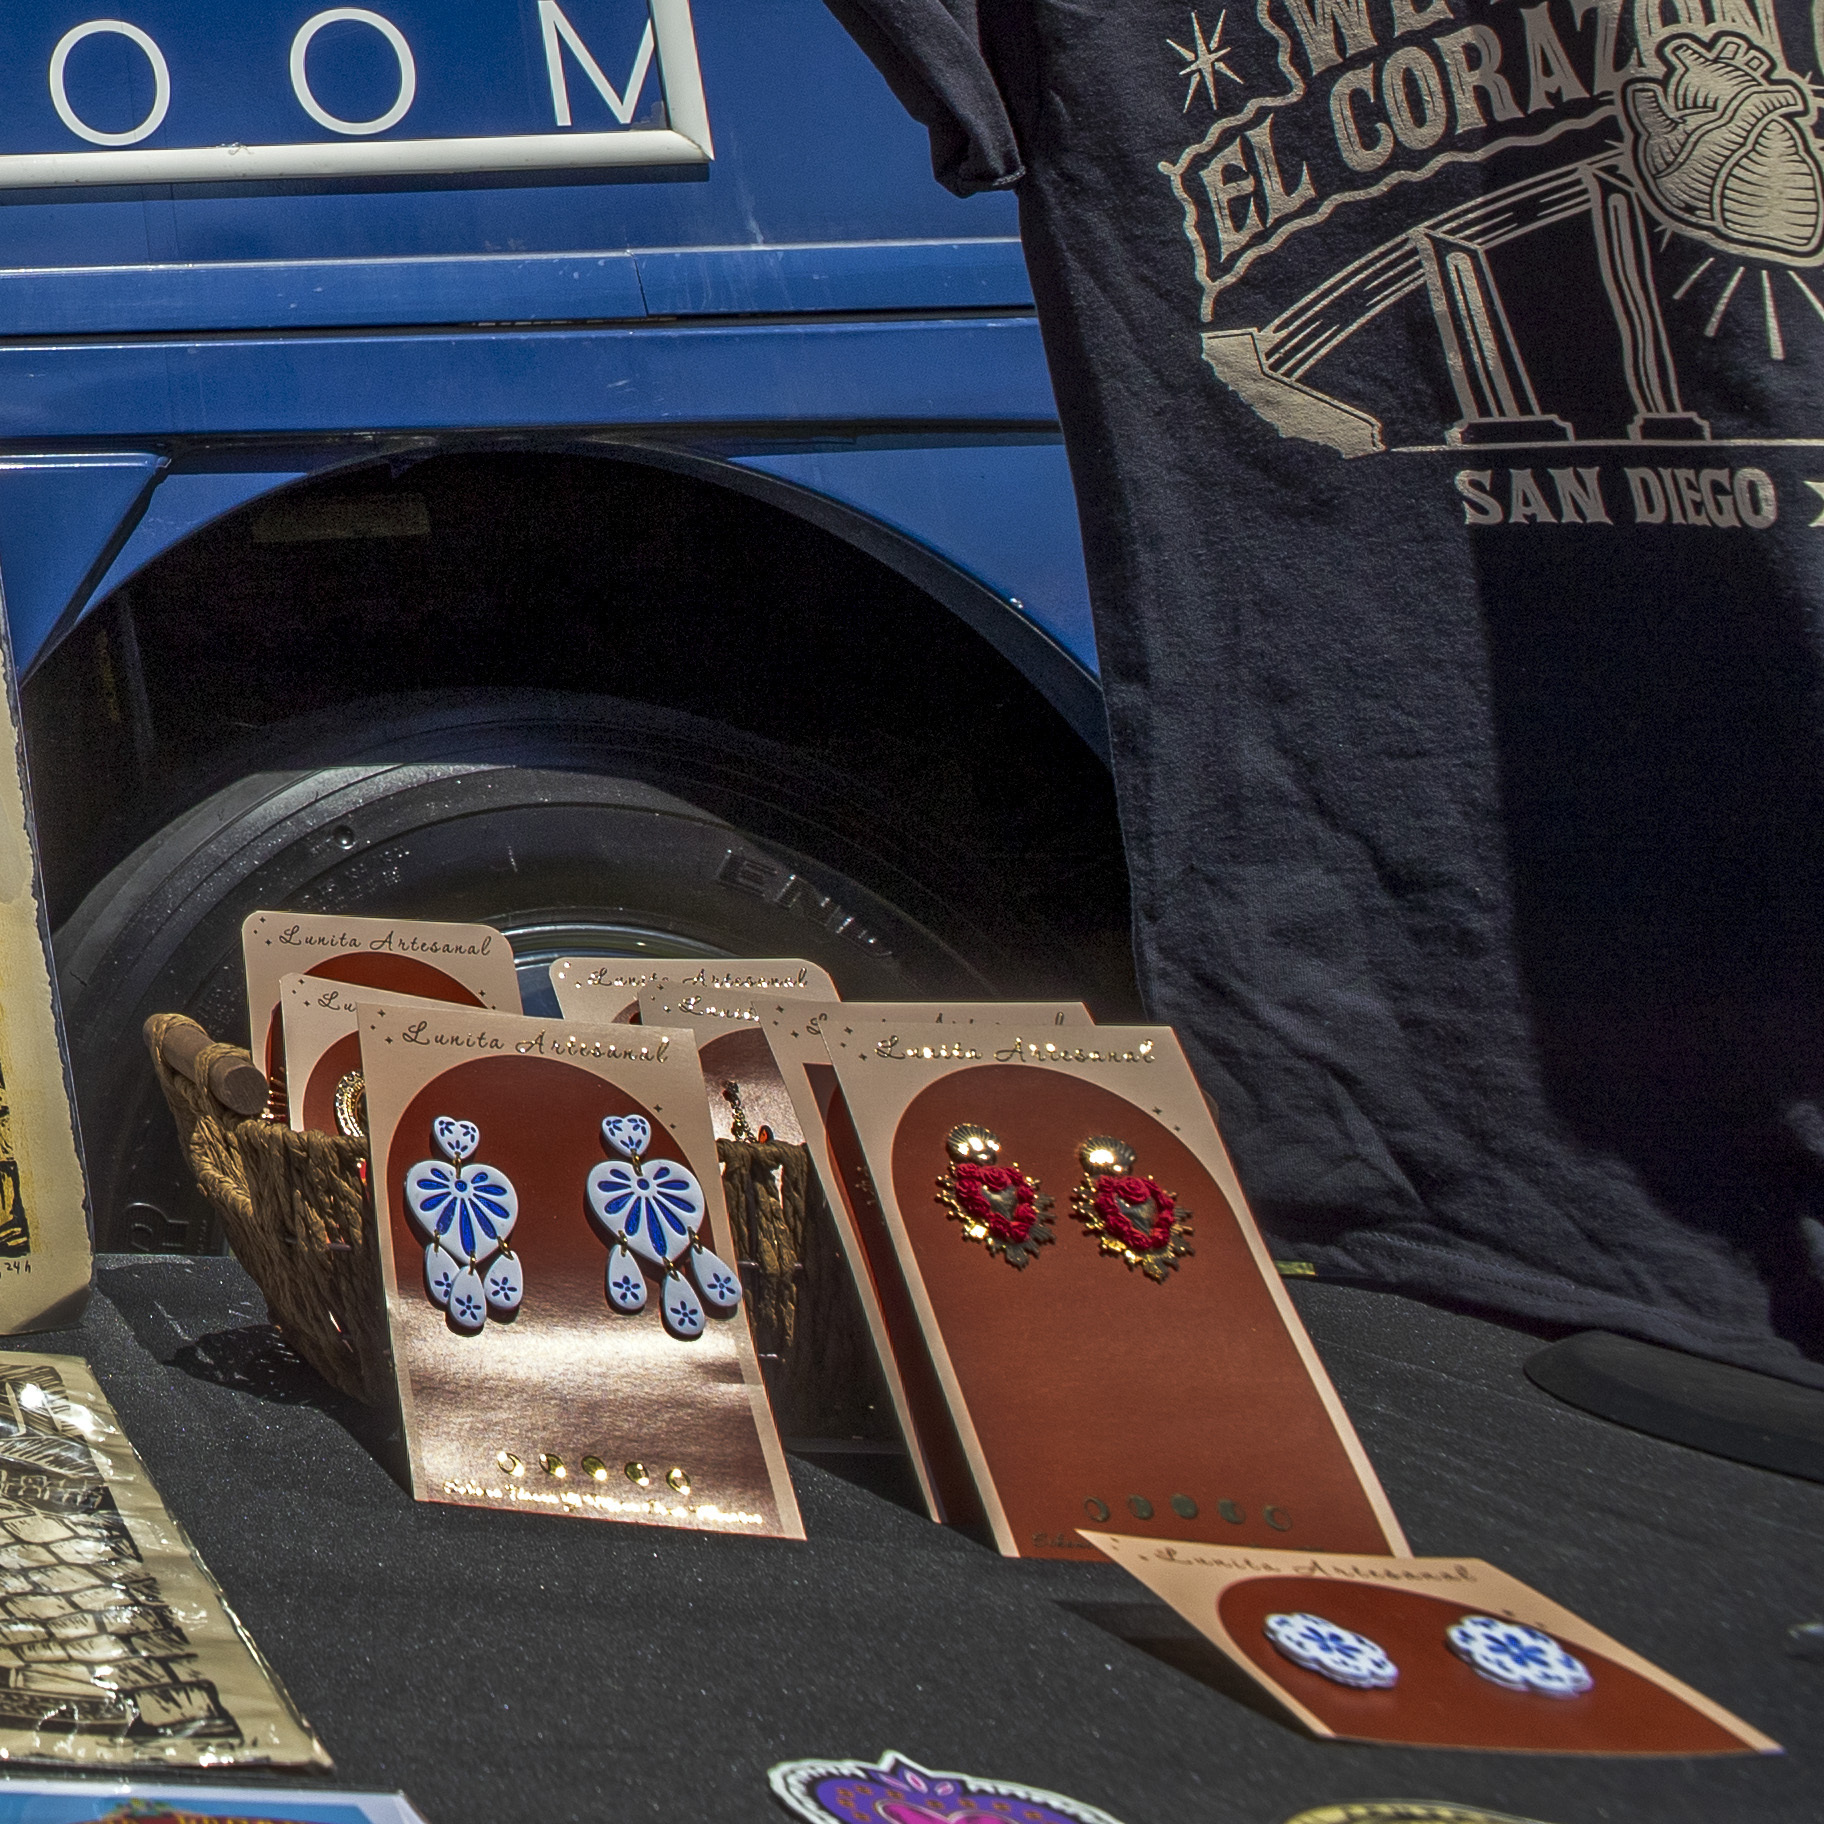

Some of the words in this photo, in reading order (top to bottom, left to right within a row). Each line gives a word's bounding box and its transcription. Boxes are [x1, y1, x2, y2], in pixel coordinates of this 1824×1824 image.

[1197, 114, 1317, 263] EL
[1453, 467, 1612, 525] SAN
[1624, 467, 1778, 529] DIEGO
[278, 925, 362, 949] Lunita
[369, 929, 492, 958] Artesanal
[682, 968, 809, 990] Artesanal
[402, 1021, 504, 1051] Lunita
[514, 1031, 670, 1064] Artesanal
[875, 1029, 984, 1060] Lunita
[993, 1037, 1156, 1065] Artesanal
